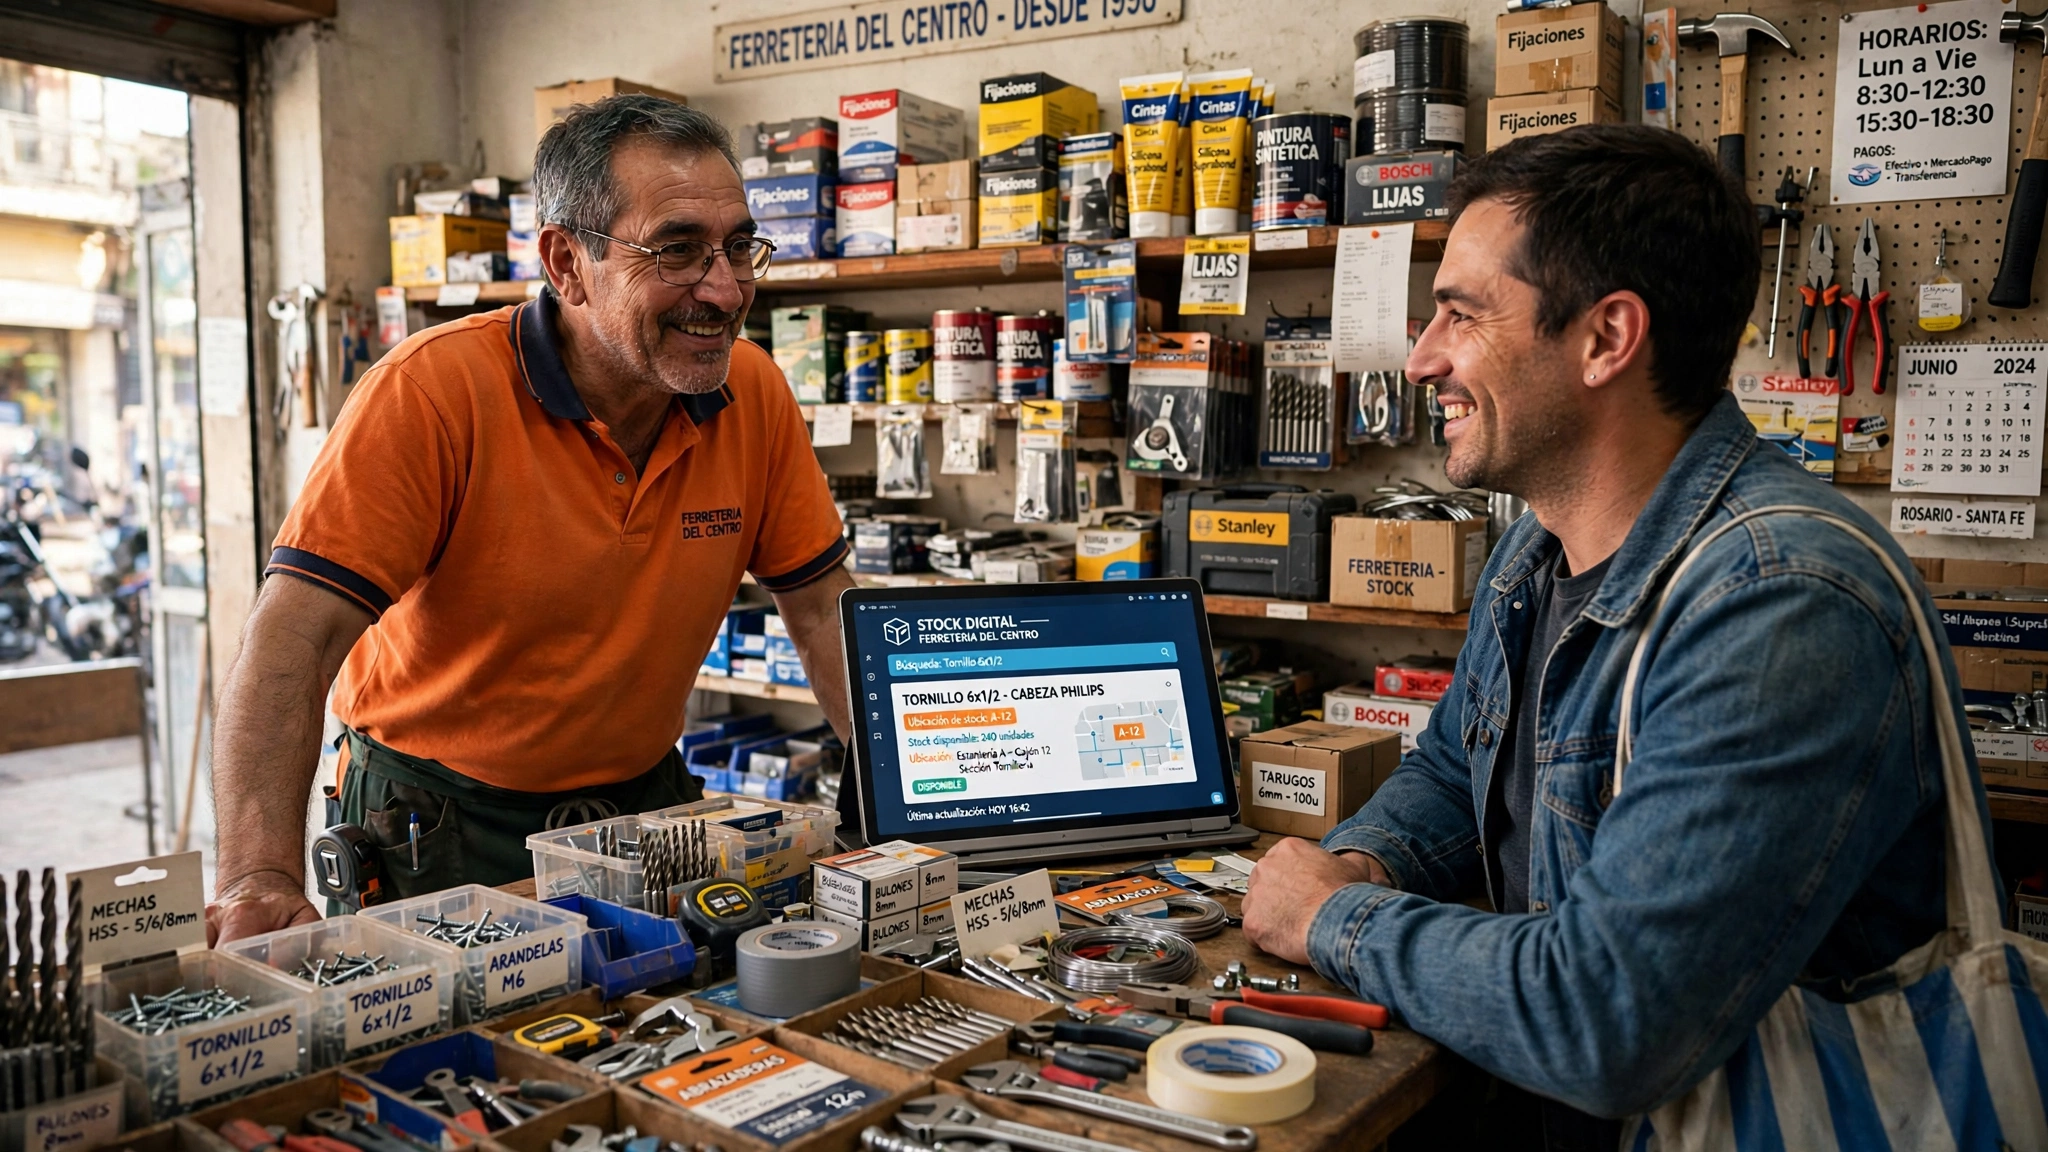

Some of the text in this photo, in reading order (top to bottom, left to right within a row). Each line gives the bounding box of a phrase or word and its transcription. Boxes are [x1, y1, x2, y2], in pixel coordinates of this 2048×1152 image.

[730, 18, 848, 69] FERRETERIA
[856, 12, 894, 52] DEL
[902, 0, 988, 45] CENTRO
[1014, 0, 1089, 31] DESDE
[1508, 25, 1585, 52] Fijaciones
[1859, 19, 1988, 50] HORARIOS:
[1858, 48, 1977, 78] Lun a Vie
[985, 81, 1037, 101] Fijaciones
[1856, 75, 1986, 106] 8:30-12:30
[843, 97, 891, 116] Fijaciones
[1131, 103, 1167, 118] Cintas
[1200, 100, 1236, 115] Cintas
[1499, 111, 1577, 134] Fijaciones
[1855, 103, 1994, 133] 15:30-18:30
[1257, 126, 1314, 147] PINTURA
[1255, 142, 1320, 166] SINTÉTICA
[1853, 145, 1896, 159] PAGOS:
[1379, 162, 1432, 180] BOSCH
[1885, 155, 1992, 171] Efectivo MercadoPago
[1895, 169, 1957, 182] Transferencia
[986, 177, 1037, 196] Fijaciones
[748, 186, 810, 209] Fijaciones
[840, 187, 888, 208] Fijaciones
[1372, 186, 1425, 209] LIJAS
[1192, 253, 1238, 278] LIJAS
[1907, 358, 2036, 376] JUNIO 2024
[1986, 390, 1992, 398] T
[1948, 402, 2030, 412] 1 2 2 3 4
[1927, 417, 1936, 427] 7
[1946, 418, 1953, 427] 8
[1965, 418, 1971, 427] 8
[1984, 418, 1991, 427] 9
[2002, 419, 2013, 427] 10
[2022, 419, 2031, 427] 11
[1924, 433, 2031, 442] 14 15 15 16 17 18
[1923, 448, 1933, 457] 21
[1941, 448, 1953, 457] 22
[1961, 449, 1973, 457] 23
[1979, 449, 1991, 458] 23
[1999, 449, 2011, 458] 24
[2018, 449, 2030, 458] 25
[1979, 464, 1991, 473] 30
[1998, 465, 2009, 473] 31
[682, 507, 742, 525] FERRETERIA
[1900, 506, 1953, 522] ROSARIO
[1965, 509, 2007, 525] SANTA
[2010, 510, 2025, 526] FE
[682, 521, 742, 540] DEL CENTRO
[1218, 518, 1276, 538] Stanley
[1348, 558, 1434, 579] FERRETERIA
[1367, 578, 1414, 597] STOCK
[917, 615, 1017, 631] STOCK DIGITAL
[919, 630, 1039, 644] FERRETERIA DEL CENTRO
[902, 683, 1105, 706] TORNILLO 6x1/2 CABEZA PHILIPS
[951, 714, 962, 725] de
[990, 711, 1012, 722] A-12
[1355, 706, 1410, 727] BOSCH
[1118, 725, 1140, 739] A-12
[1041, 746, 1051, 755] 12
[917, 780, 962, 792] DISPONIBLE
[1259, 769, 1316, 789] TARUGOS
[1258, 787, 1283, 802] 6mm
[1293, 791, 1319, 807] 100u
[907, 810, 934, 822] Última
[988, 805, 1007, 815] HOY
[875, 879, 914, 899] BULONES
[925, 872, 946, 886] 8mm
[90, 894, 157, 921] MECHAS
[875, 900, 896, 913] 8mm
[964, 886, 1015, 915] MECHAS
[922, 913, 945, 926] 8mm
[966, 916, 990, 934] HSS
[1000, 898, 1046, 923] 5/6/8mm
[89, 922, 118, 942] HSS
[134, 912, 197, 934] 5/6/8mm
[872, 919, 910, 941] BULONES
[489, 937, 564, 973] ARANDELAS
[502, 971, 525, 993] M6
[349, 974, 433, 1013] TORNILLOS
[362, 1004, 412, 1035] 6x1/2
[186, 1014, 293, 1062] TORNILLOS
[201, 1050, 265, 1086] 6x1/2
[678, 1055, 786, 1102] ABRAZADERAS
